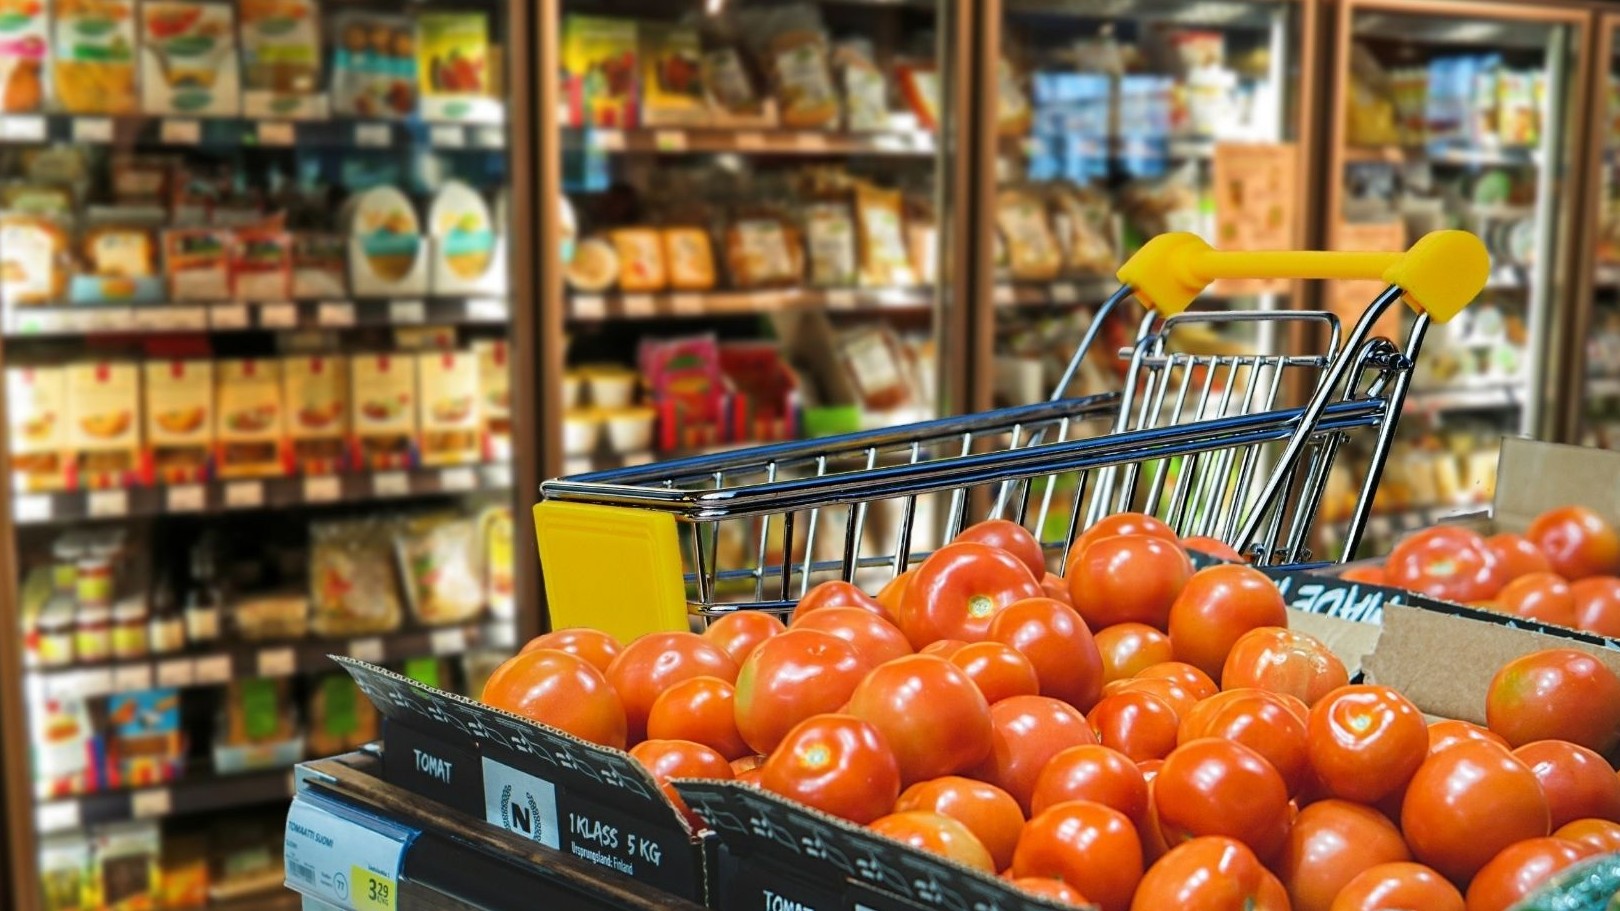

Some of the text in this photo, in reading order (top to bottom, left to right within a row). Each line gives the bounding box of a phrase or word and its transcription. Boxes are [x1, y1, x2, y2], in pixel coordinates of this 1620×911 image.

[413, 749, 452, 784] TOMAT
[511, 802, 531, 833] N
[576, 815, 618, 848] KLASS
[627, 834, 636, 855] 5
[640, 838, 661, 866] KG
[613, 857, 633, 875] Finland
